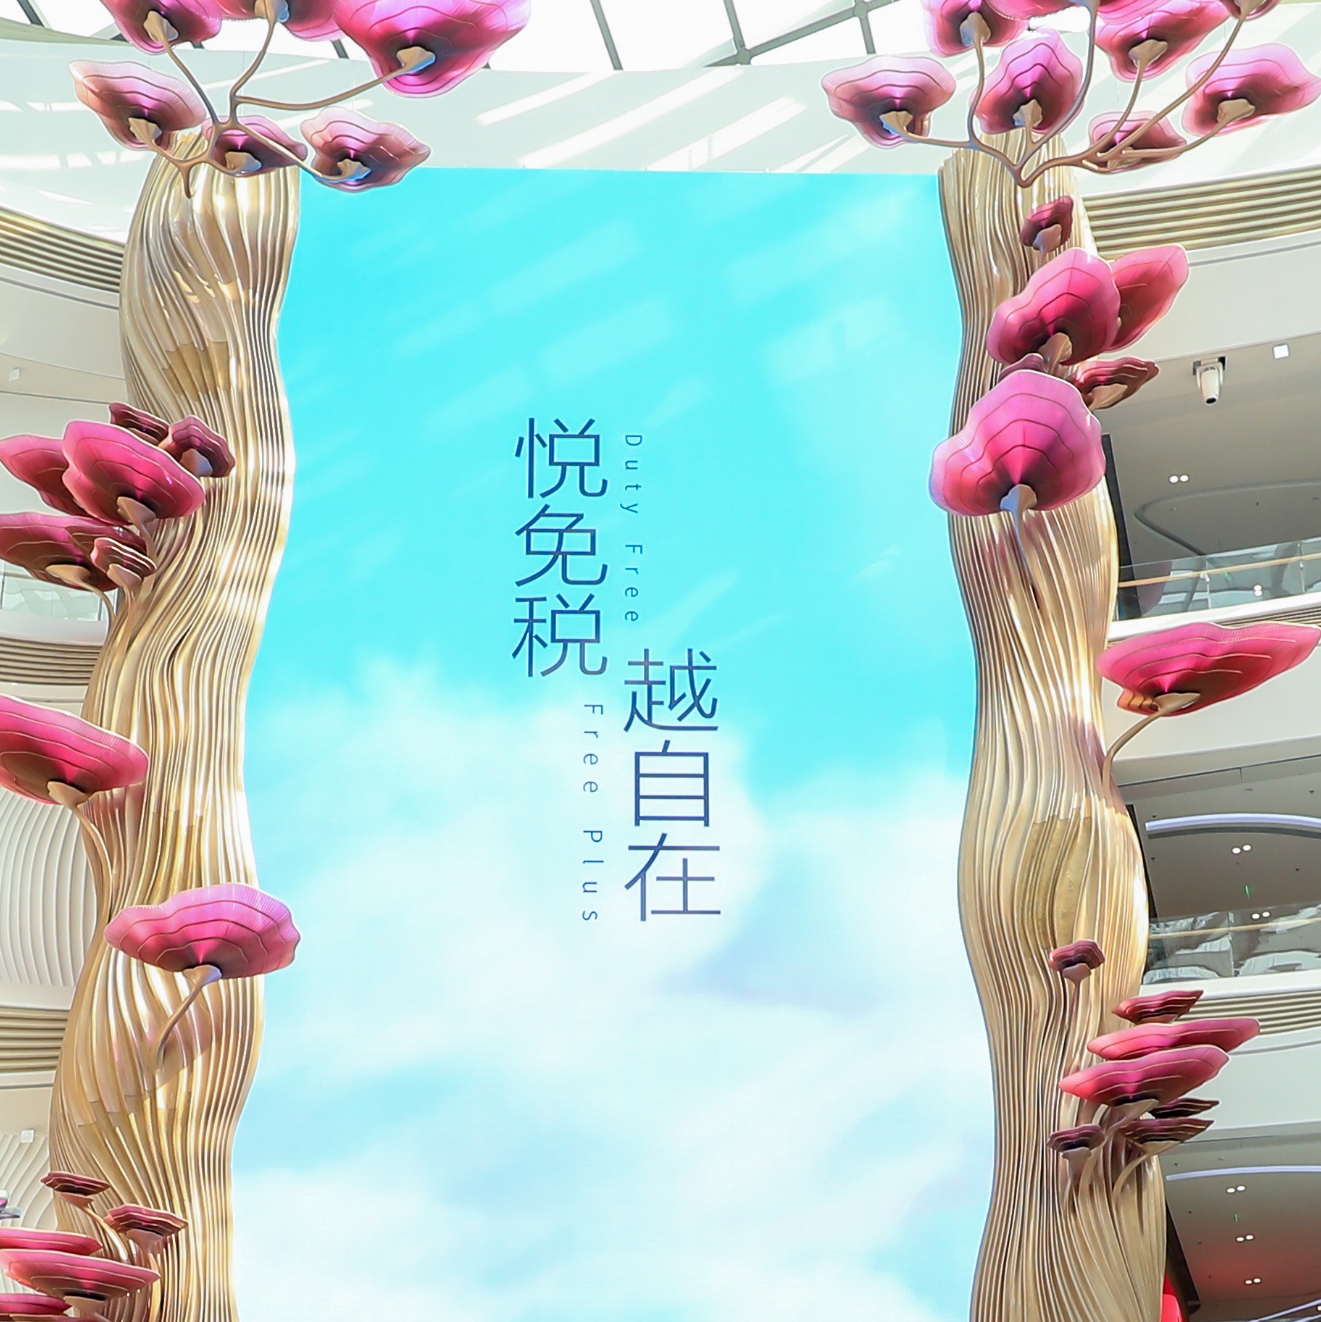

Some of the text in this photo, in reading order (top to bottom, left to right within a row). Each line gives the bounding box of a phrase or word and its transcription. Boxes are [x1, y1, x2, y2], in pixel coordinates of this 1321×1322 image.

[511, 416, 609, 678] 悦免税
[620, 433, 643, 624] Duty Free
[582, 703, 603, 922] Free Plus
[623, 647, 721, 922] 越自在
